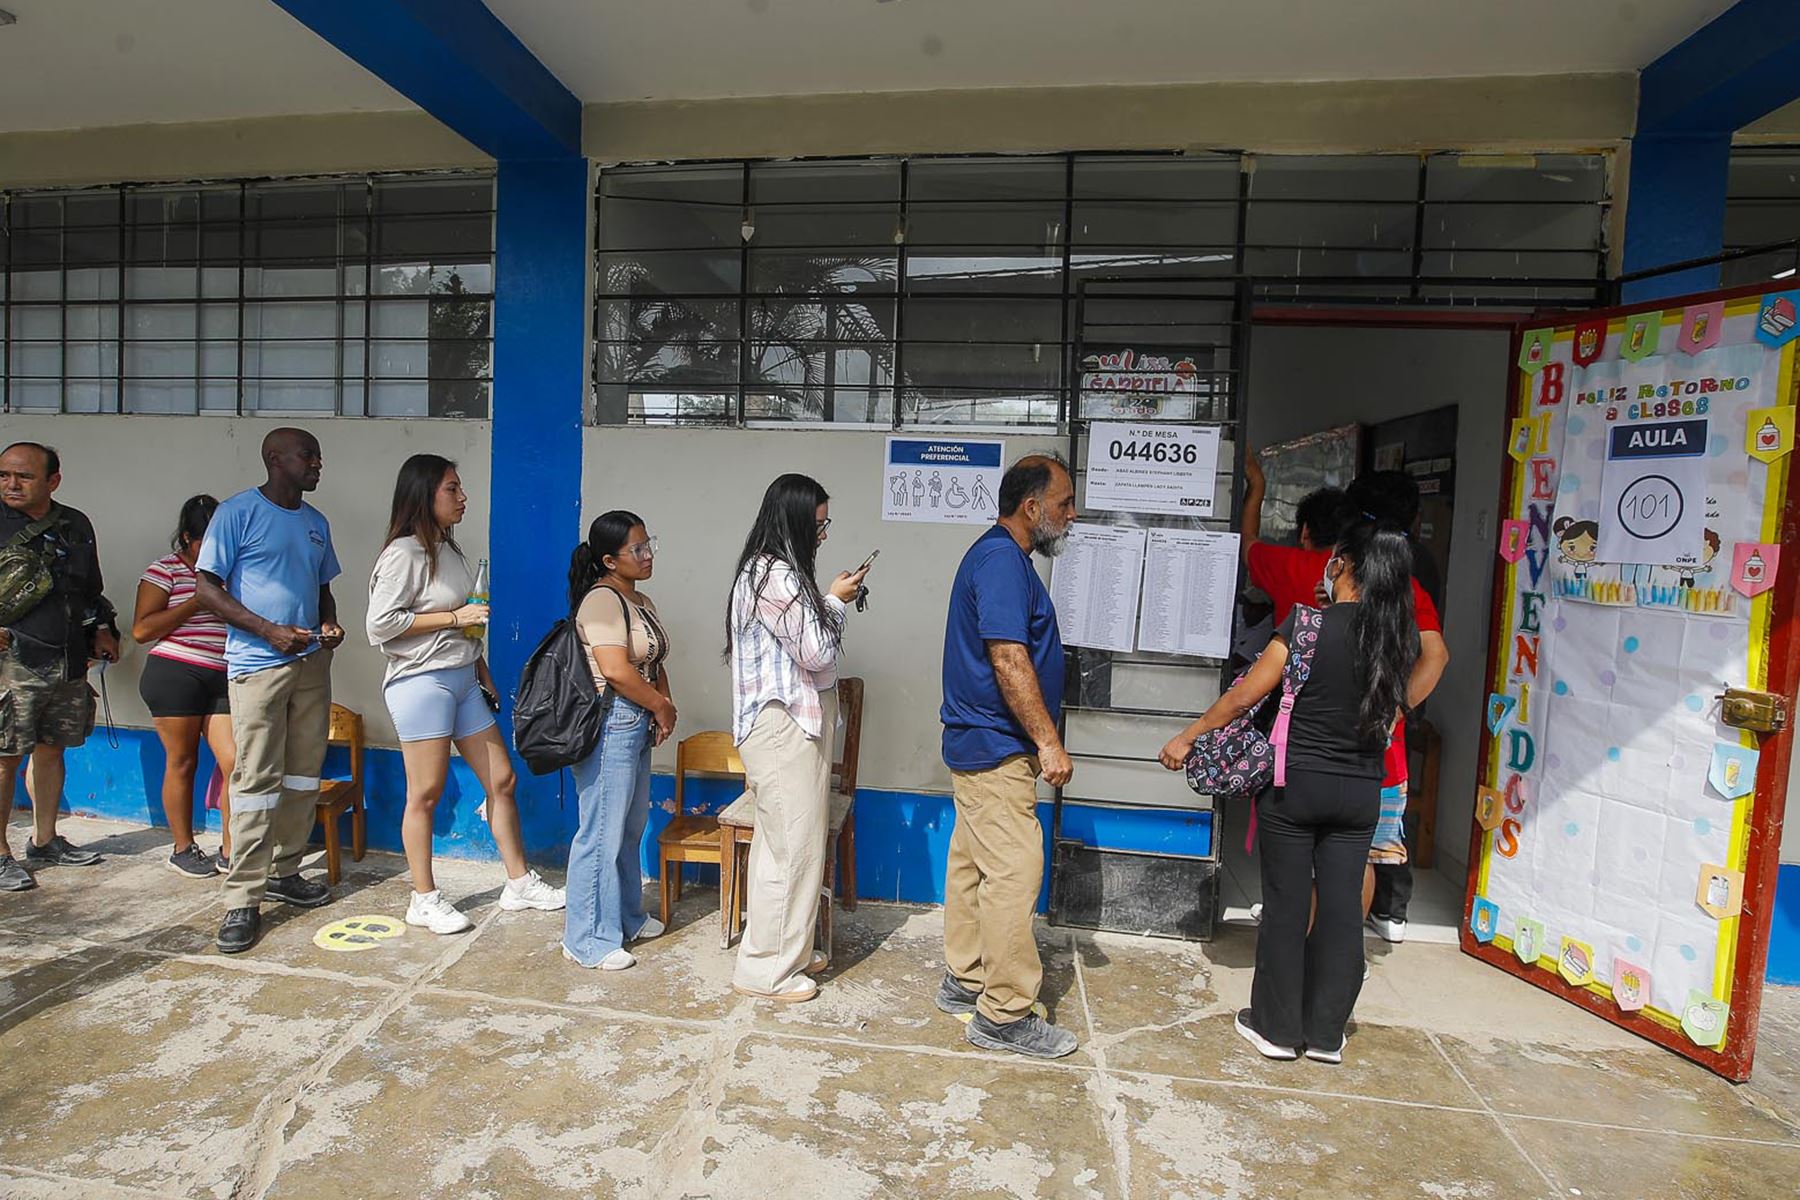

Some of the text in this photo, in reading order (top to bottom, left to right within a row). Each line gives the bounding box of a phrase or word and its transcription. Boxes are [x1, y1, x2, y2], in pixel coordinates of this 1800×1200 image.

[1155, 431, 1178, 439] MESA
[1628, 428, 1687, 448] AULA
[928, 445, 964, 453] ATENCIÓN
[1109, 440, 1197, 464] 044636
[920, 453, 970, 462] PREFERENCIAL
[1625, 495, 1669, 519] 101
